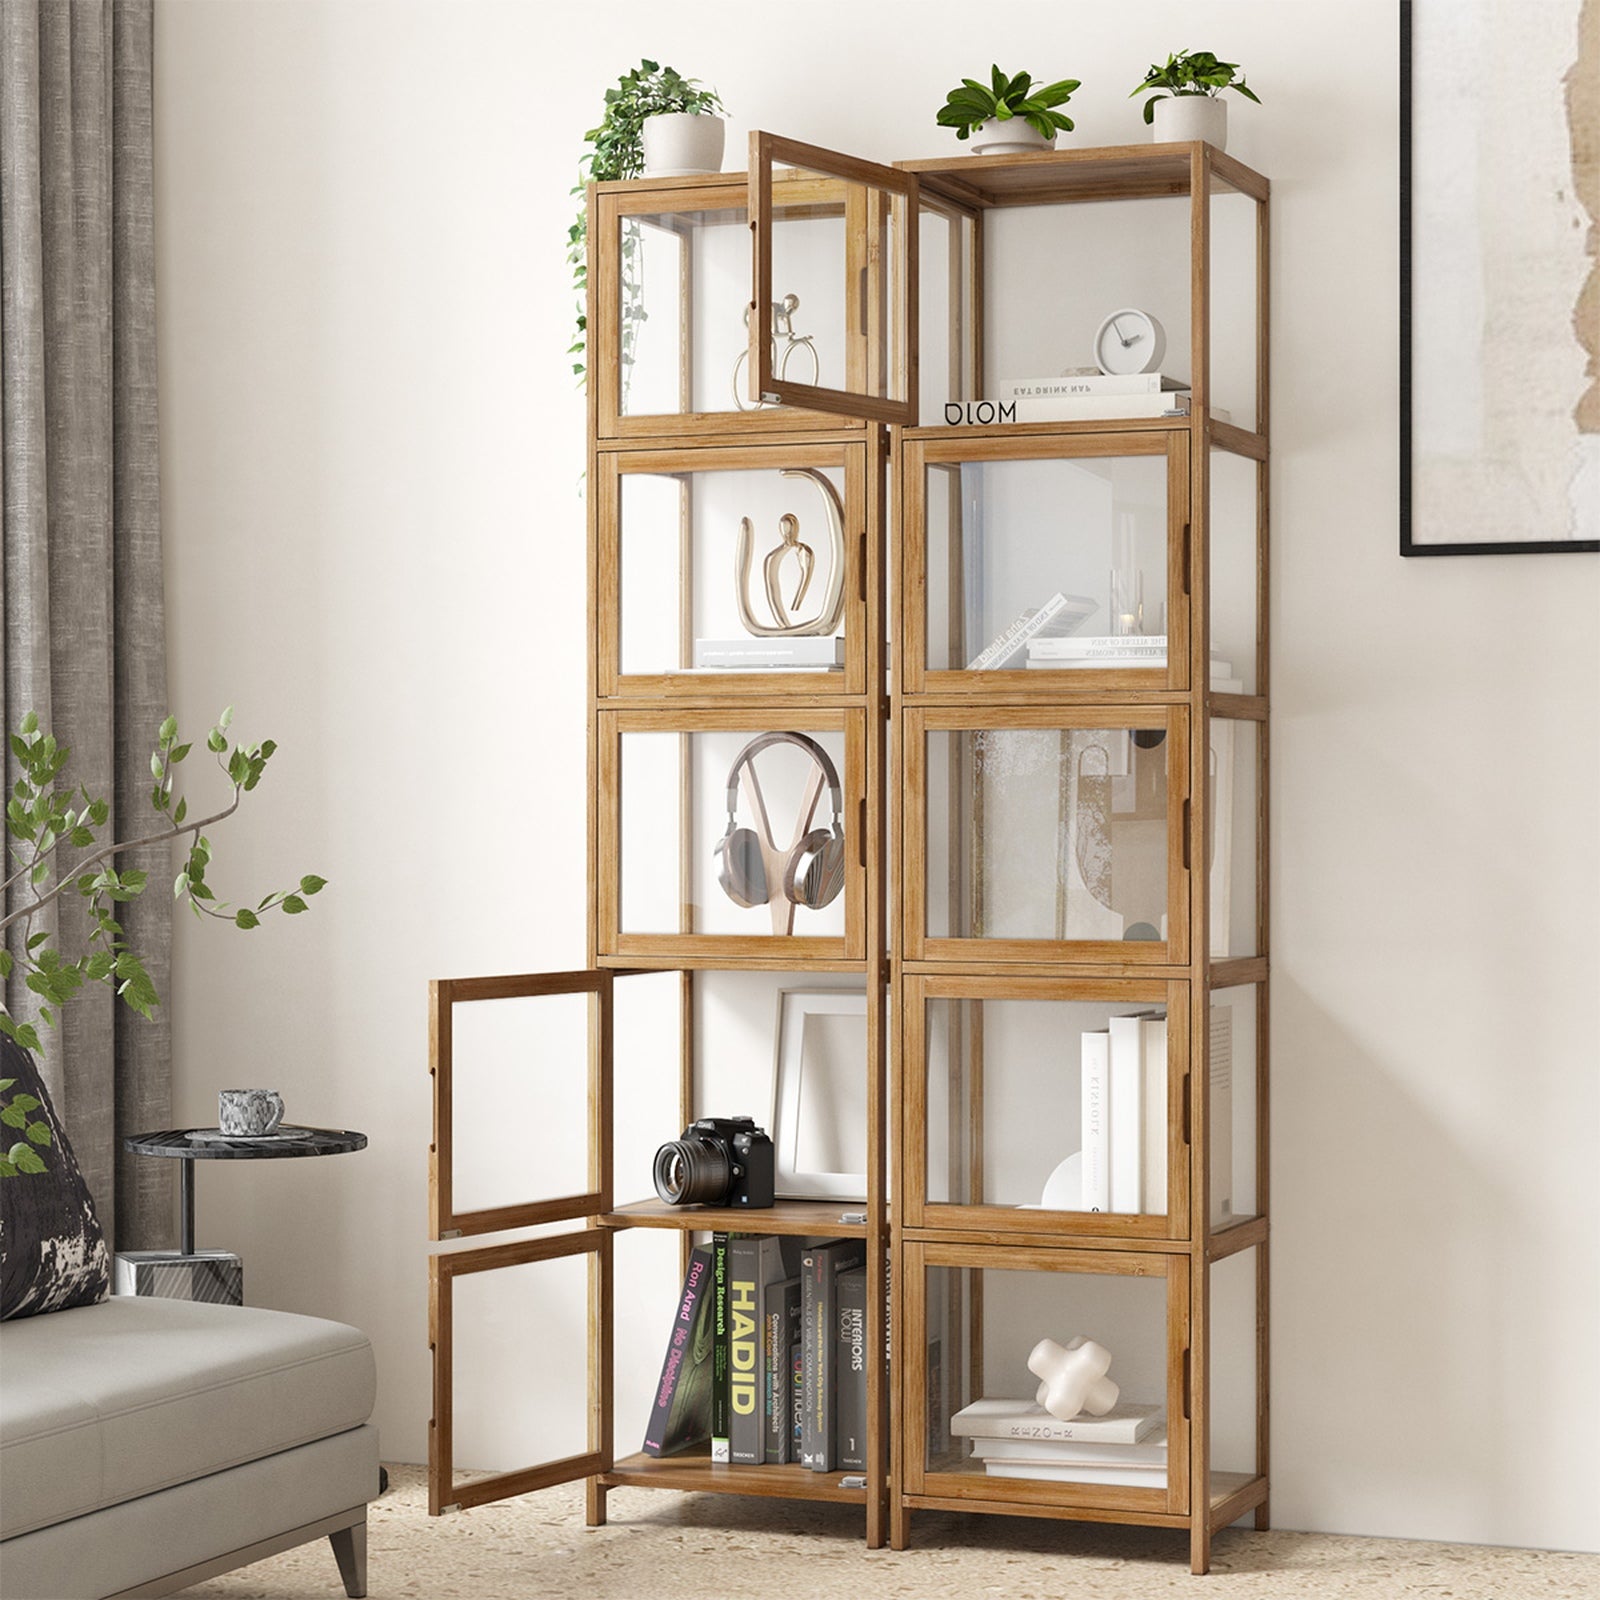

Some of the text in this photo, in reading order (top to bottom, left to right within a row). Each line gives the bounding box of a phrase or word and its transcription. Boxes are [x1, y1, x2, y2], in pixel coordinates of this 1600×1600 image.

[690, 1261, 704, 1287] Ron
[716, 1247, 725, 1286] Design
[680, 1290, 697, 1322] Arad
[716, 1286, 726, 1335] Research
[731, 1280, 756, 1416] HADID
[851, 1308, 864, 1371] INTERIORS
[772, 1312, 780, 1433] Conversations with Architects
[848, 1437, 856, 1451] 1
[1010, 1426, 1073, 1438] RENOIR
